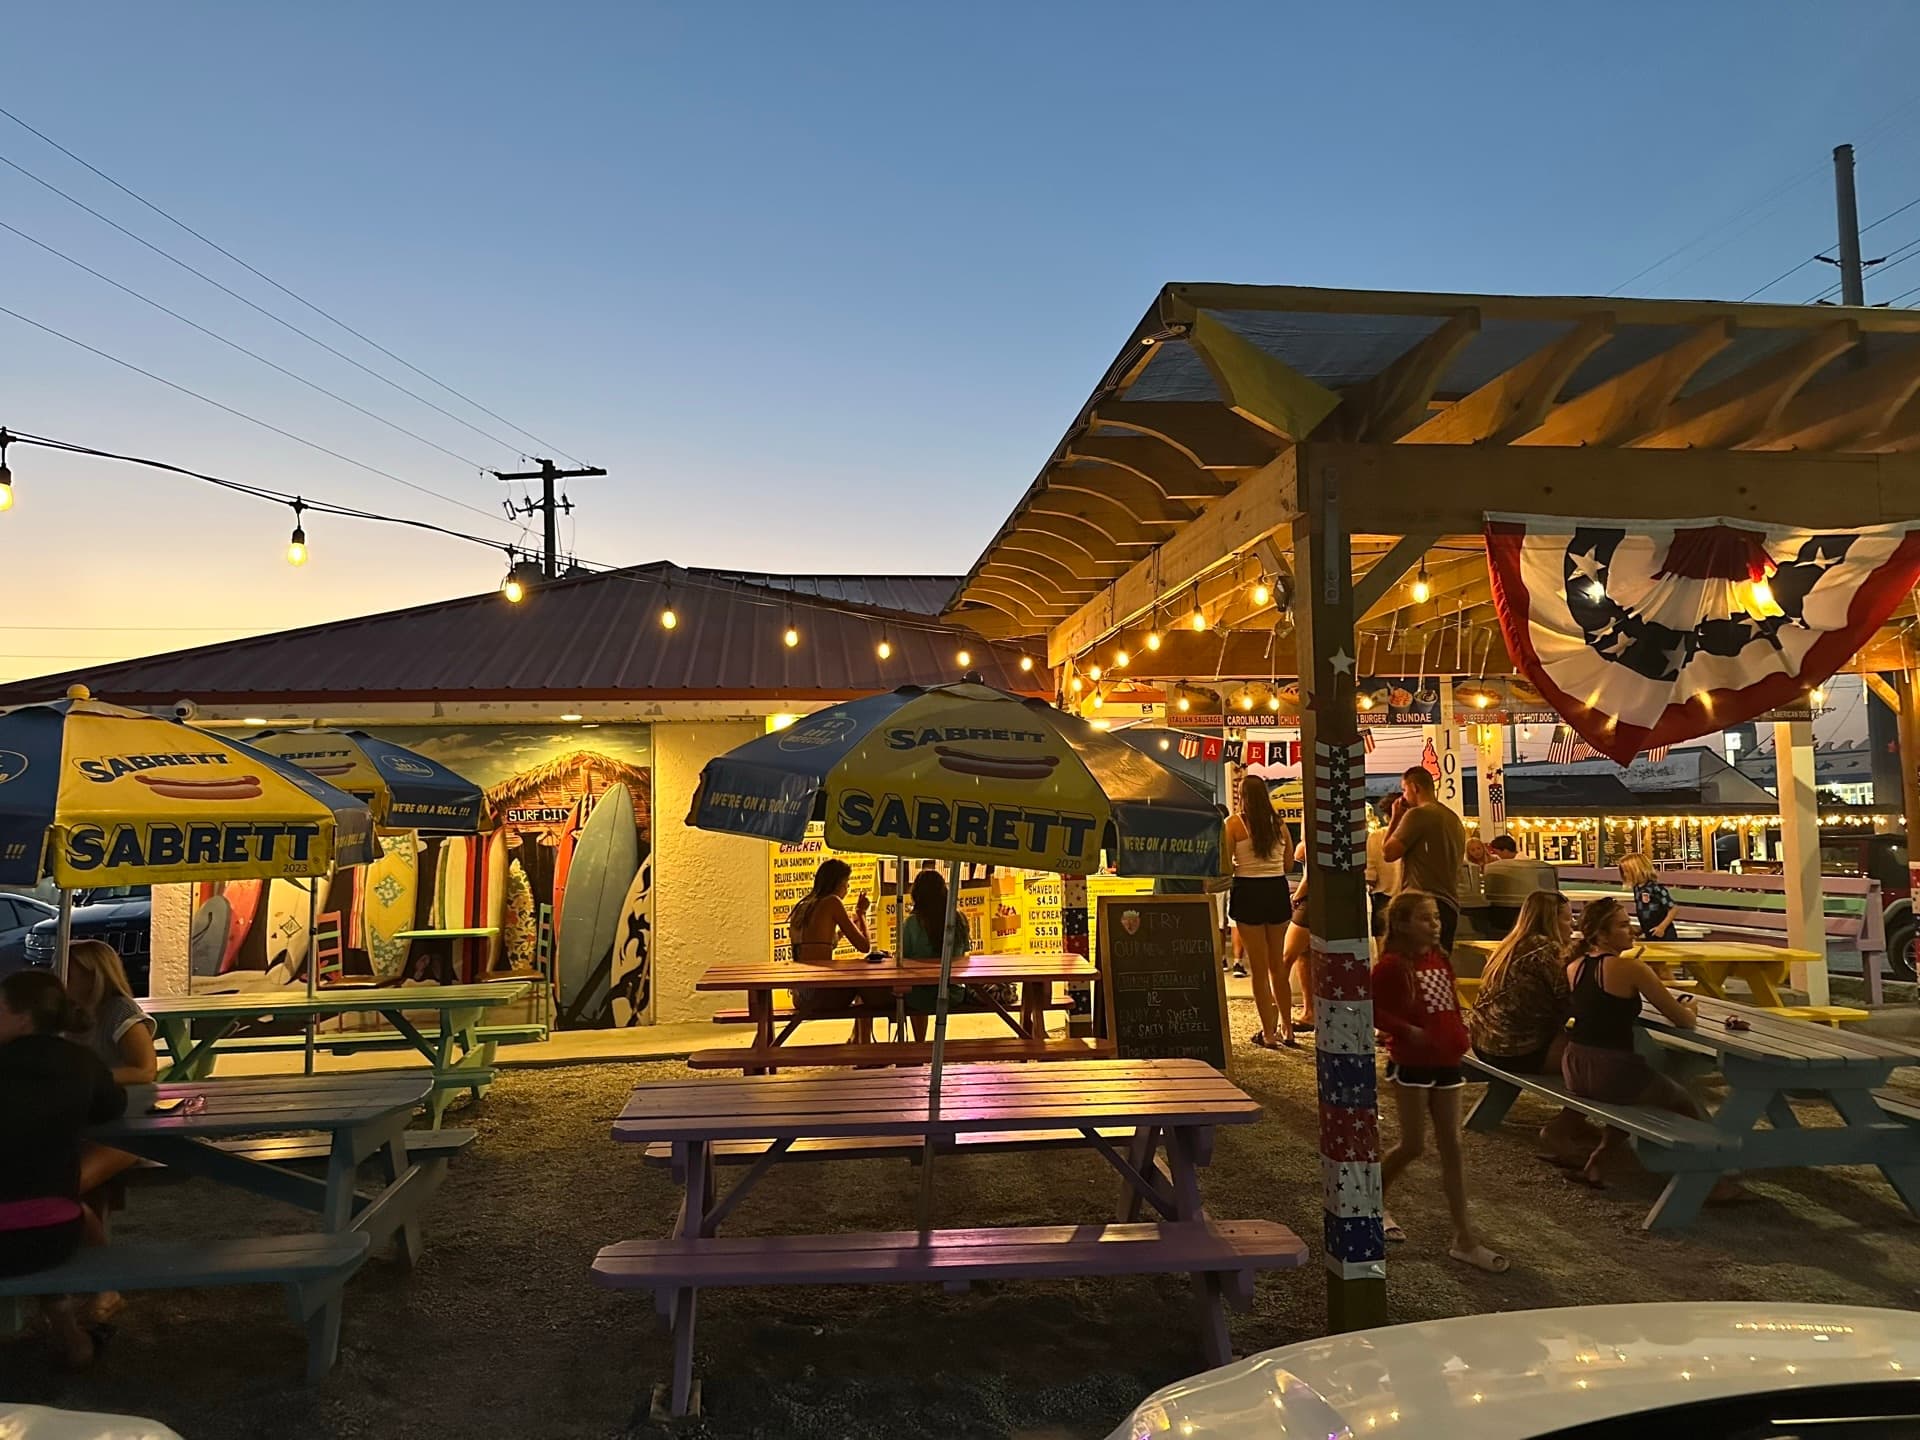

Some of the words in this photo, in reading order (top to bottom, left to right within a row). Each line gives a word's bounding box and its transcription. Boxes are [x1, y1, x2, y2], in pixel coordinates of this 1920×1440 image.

[1227, 715, 1259, 726] CAROLINA
[1260, 715, 1275, 726] DOG
[1360, 714, 1387, 724] BURGER
[1396, 713, 1433, 723] SUNDAE
[1539, 713, 1553, 722] DOG
[884, 727, 1046, 750] SABRETT
[279, 750, 352, 761] BRETT
[73, 752, 228, 783] SABRETT
[743, 796, 759, 810] ON
[759, 799, 767, 812] A
[416, 804, 428, 815] ON
[428, 805, 436, 814] A
[437, 806, 458, 816] ROLL
[508, 809, 540, 822] SURF
[838, 788, 1097, 857] SABRETT
[66, 822, 320, 871] SABRETT
[779, 841, 823, 853] CHICKEN
[1146, 837, 1160, 851] ON
[1160, 837, 1168, 851] A
[1169, 838, 1194, 853] ROLL
[789, 857, 815, 867] SANDWICH
[1055, 857, 1081, 870] 2020
[283, 863, 308, 873] 2023
[1028, 884, 1053, 895] SHAVED
[1053, 884, 1061, 894] IC
[964, 895, 985, 906] CREAM
[1036, 896, 1058, 906] $4.50
[1029, 910, 1041, 920] ICY
[1035, 926, 1059, 936] $5.50
[1049, 939, 1062, 948] SHAK
